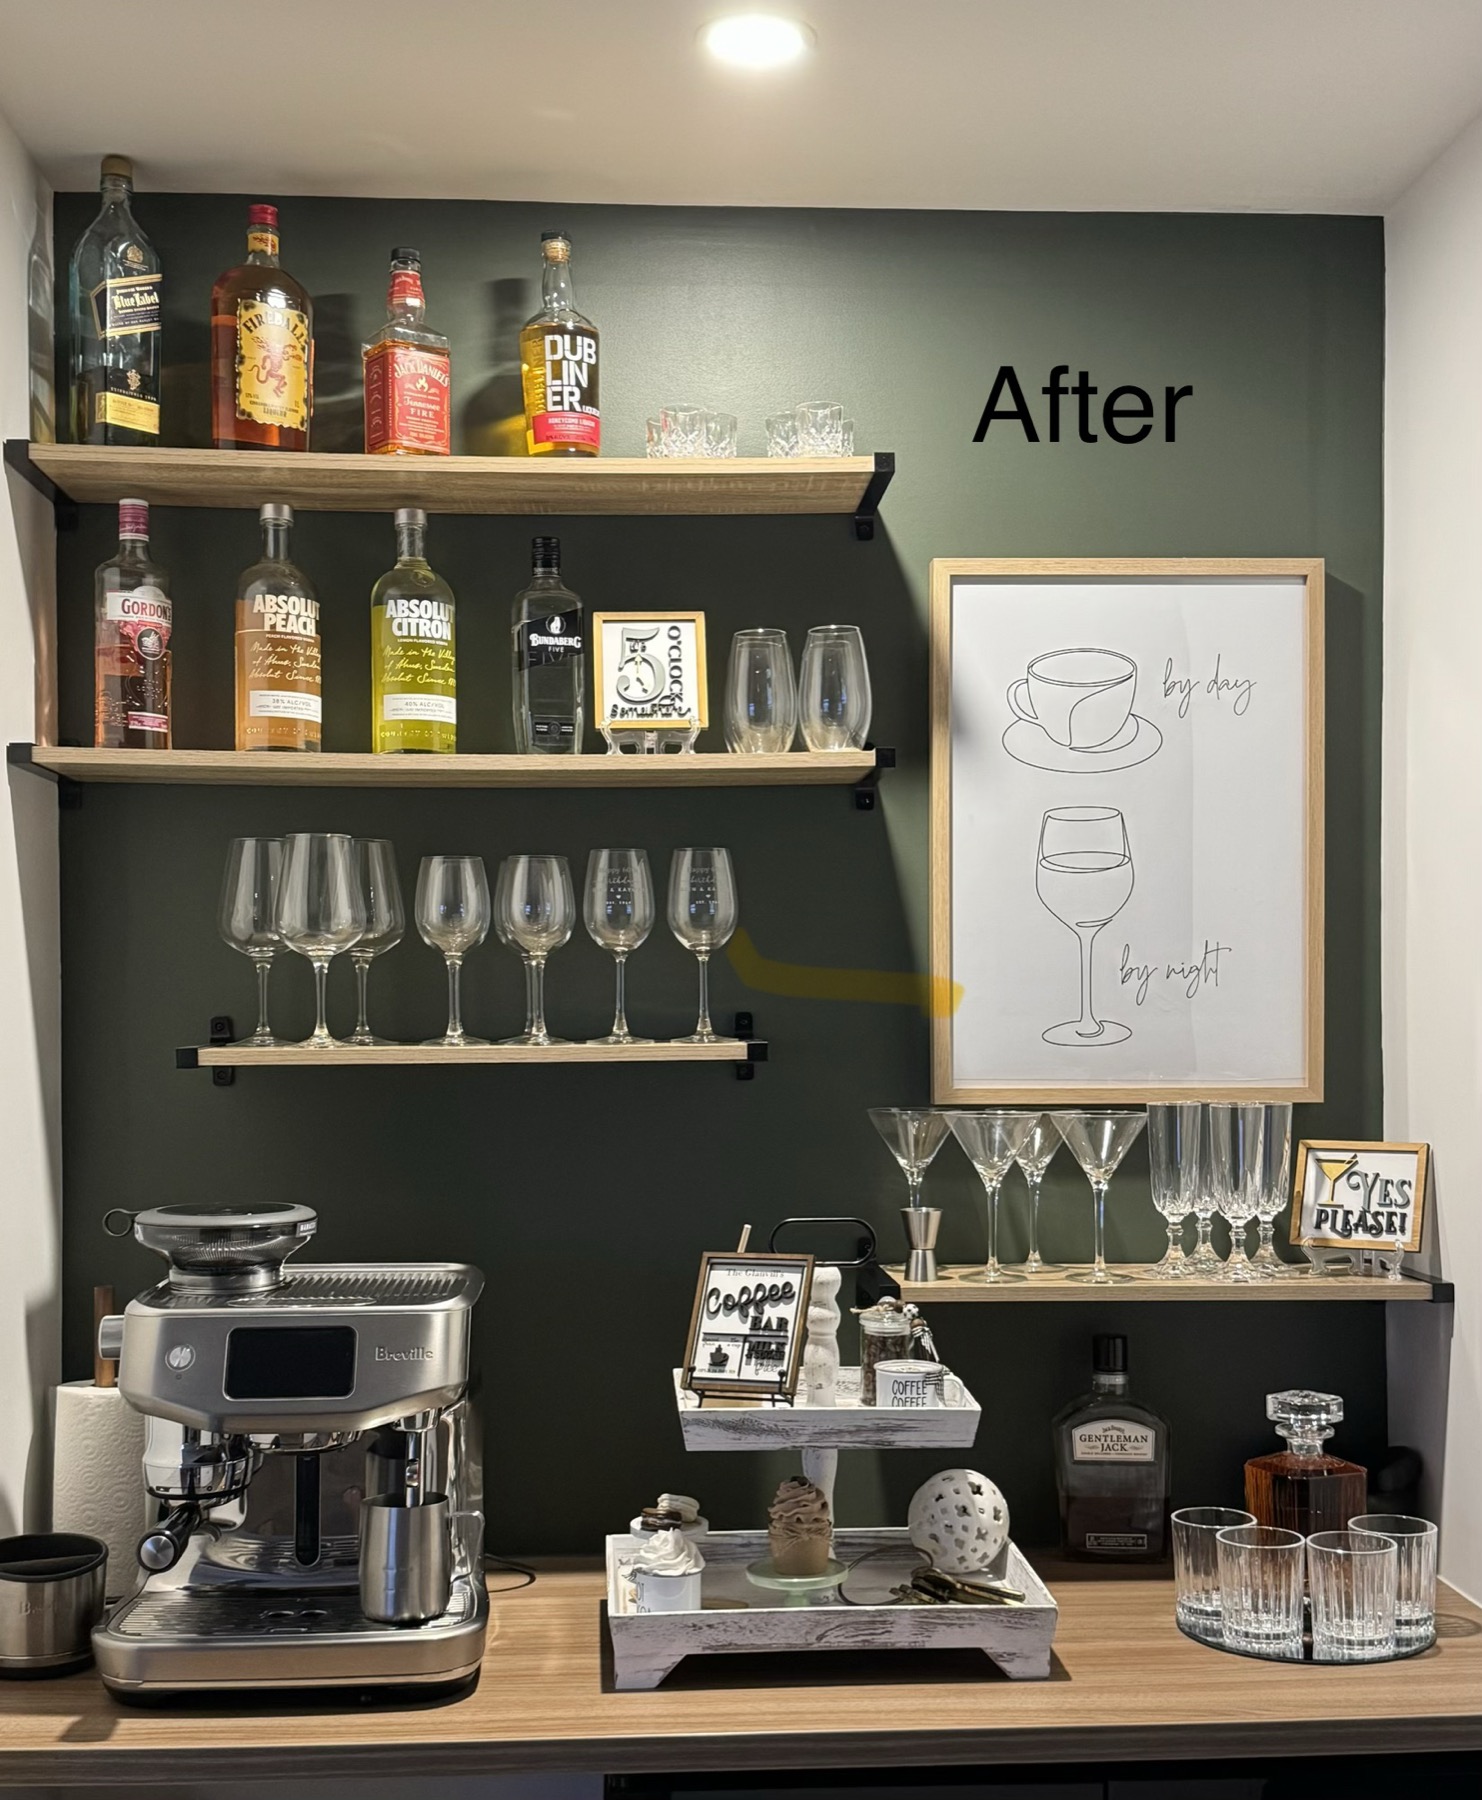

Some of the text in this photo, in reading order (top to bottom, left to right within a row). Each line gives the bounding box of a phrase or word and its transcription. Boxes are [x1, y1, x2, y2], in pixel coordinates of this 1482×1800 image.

[111, 294, 135, 310] Blue
[133, 291, 159, 307] Label
[544, 334, 596, 365] DUB
[393, 362, 416, 379] JACK
[545, 360, 588, 388] LIN
[403, 395, 440, 412] Tennessee
[546, 386, 583, 412] ER
[410, 407, 435, 419] FIRE
[253, 594, 321, 620] ABSOLUT
[385, 598, 455, 623] ABSOLUT
[263, 613, 316, 637] PEACH
[392, 617, 451, 640] CITRON
[529, 633, 582, 649] BUNDABERG
[1162, 653, 1257, 718] by day
[1120, 939, 1232, 1006] by night
[1347, 1169, 1412, 1213] YES
[1313, 1208, 1408, 1239] PLEASE!
[706, 1281, 796, 1320] Coffee
[749, 1316, 790, 1332] BAR
[375, 1346, 434, 1361] Breville
[892, 1379, 928, 1396] COFFEE
[1079, 1433, 1149, 1443] GENTLEMAN
[1100, 1443, 1129, 1452] JACK
